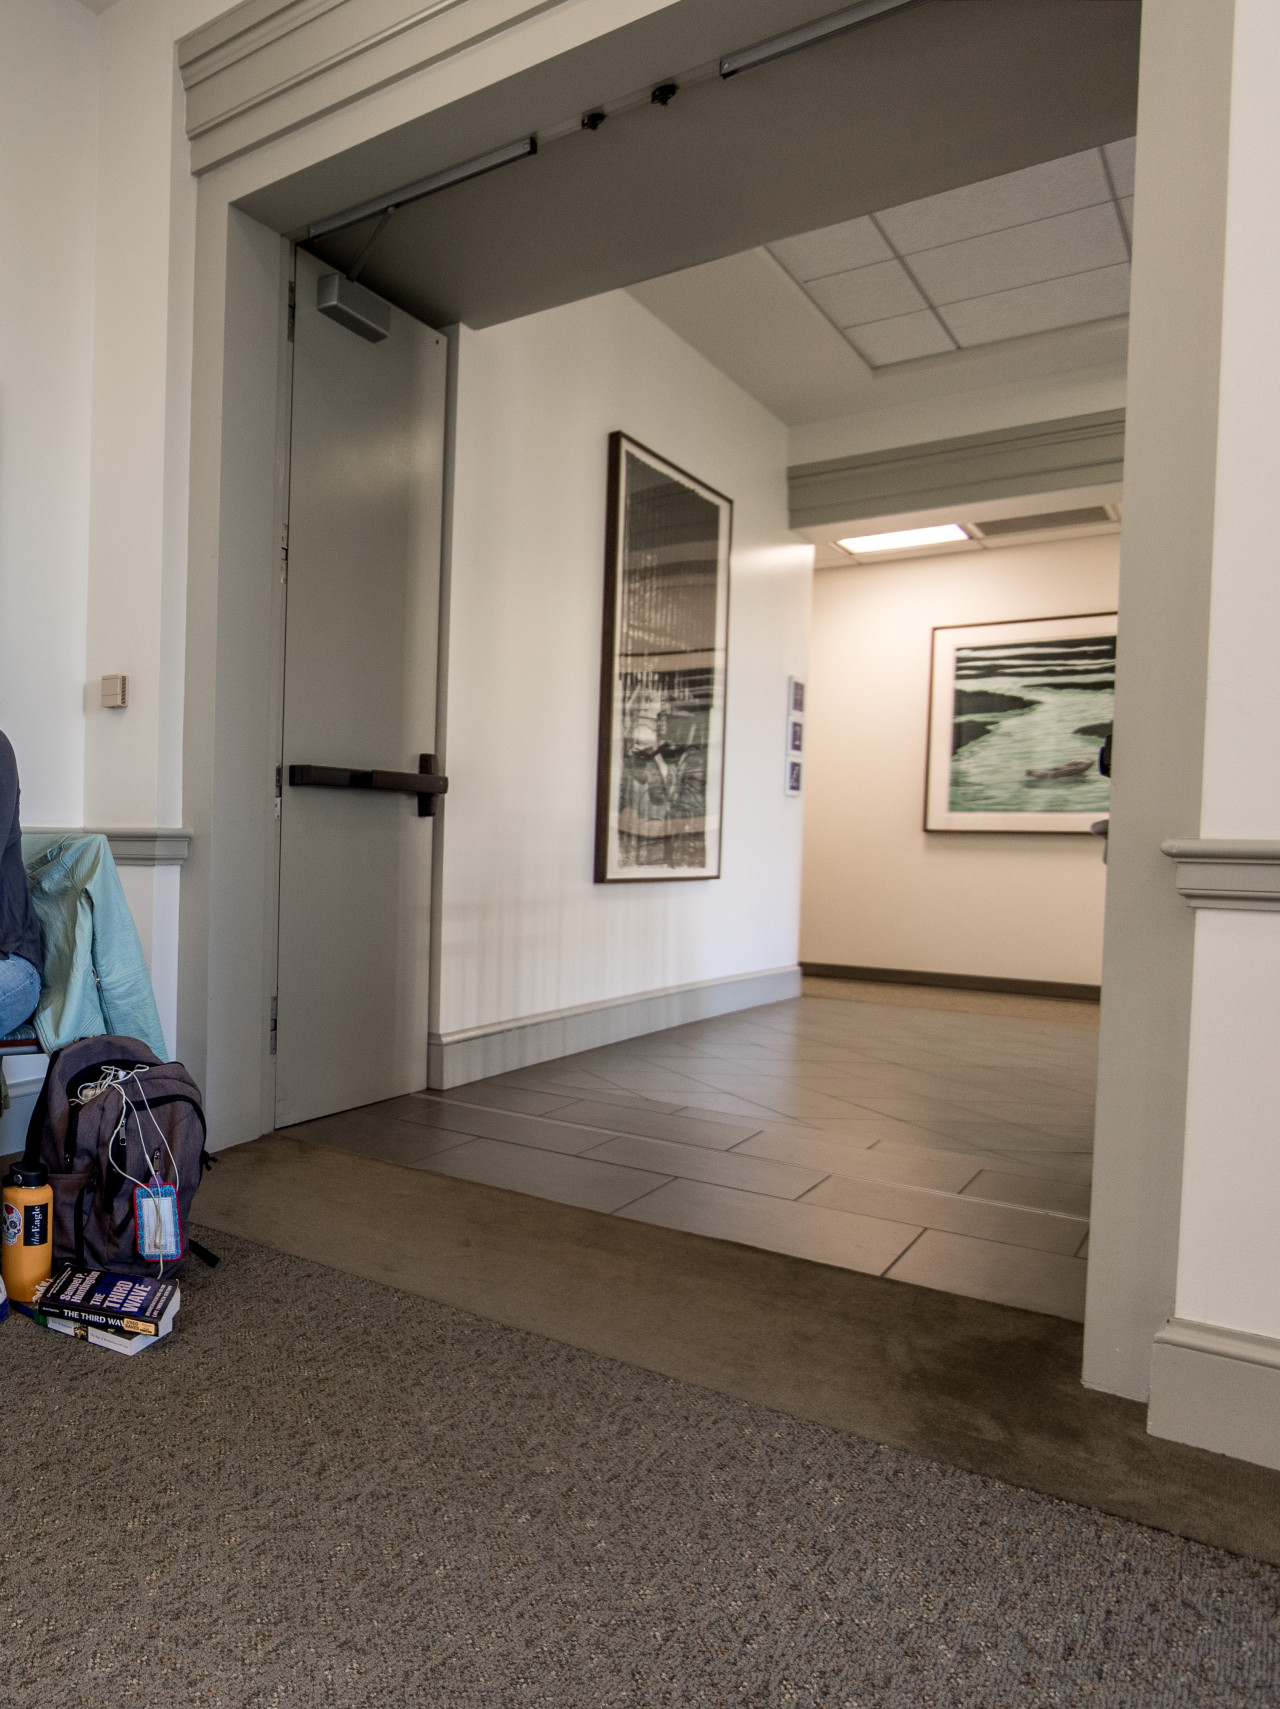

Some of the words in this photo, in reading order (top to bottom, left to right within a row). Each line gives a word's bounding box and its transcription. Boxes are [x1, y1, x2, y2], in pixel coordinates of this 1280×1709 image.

[60, 1277, 83, 1301] Samuel
[70, 1271, 101, 1303] Huntington
[89, 1292, 106, 1306] THE
[102, 1280, 134, 1308] THIRD
[120, 1283, 152, 1312] WAVE
[63, 1309, 80, 1319] THE
[80, 1312, 106, 1324] THIRD
